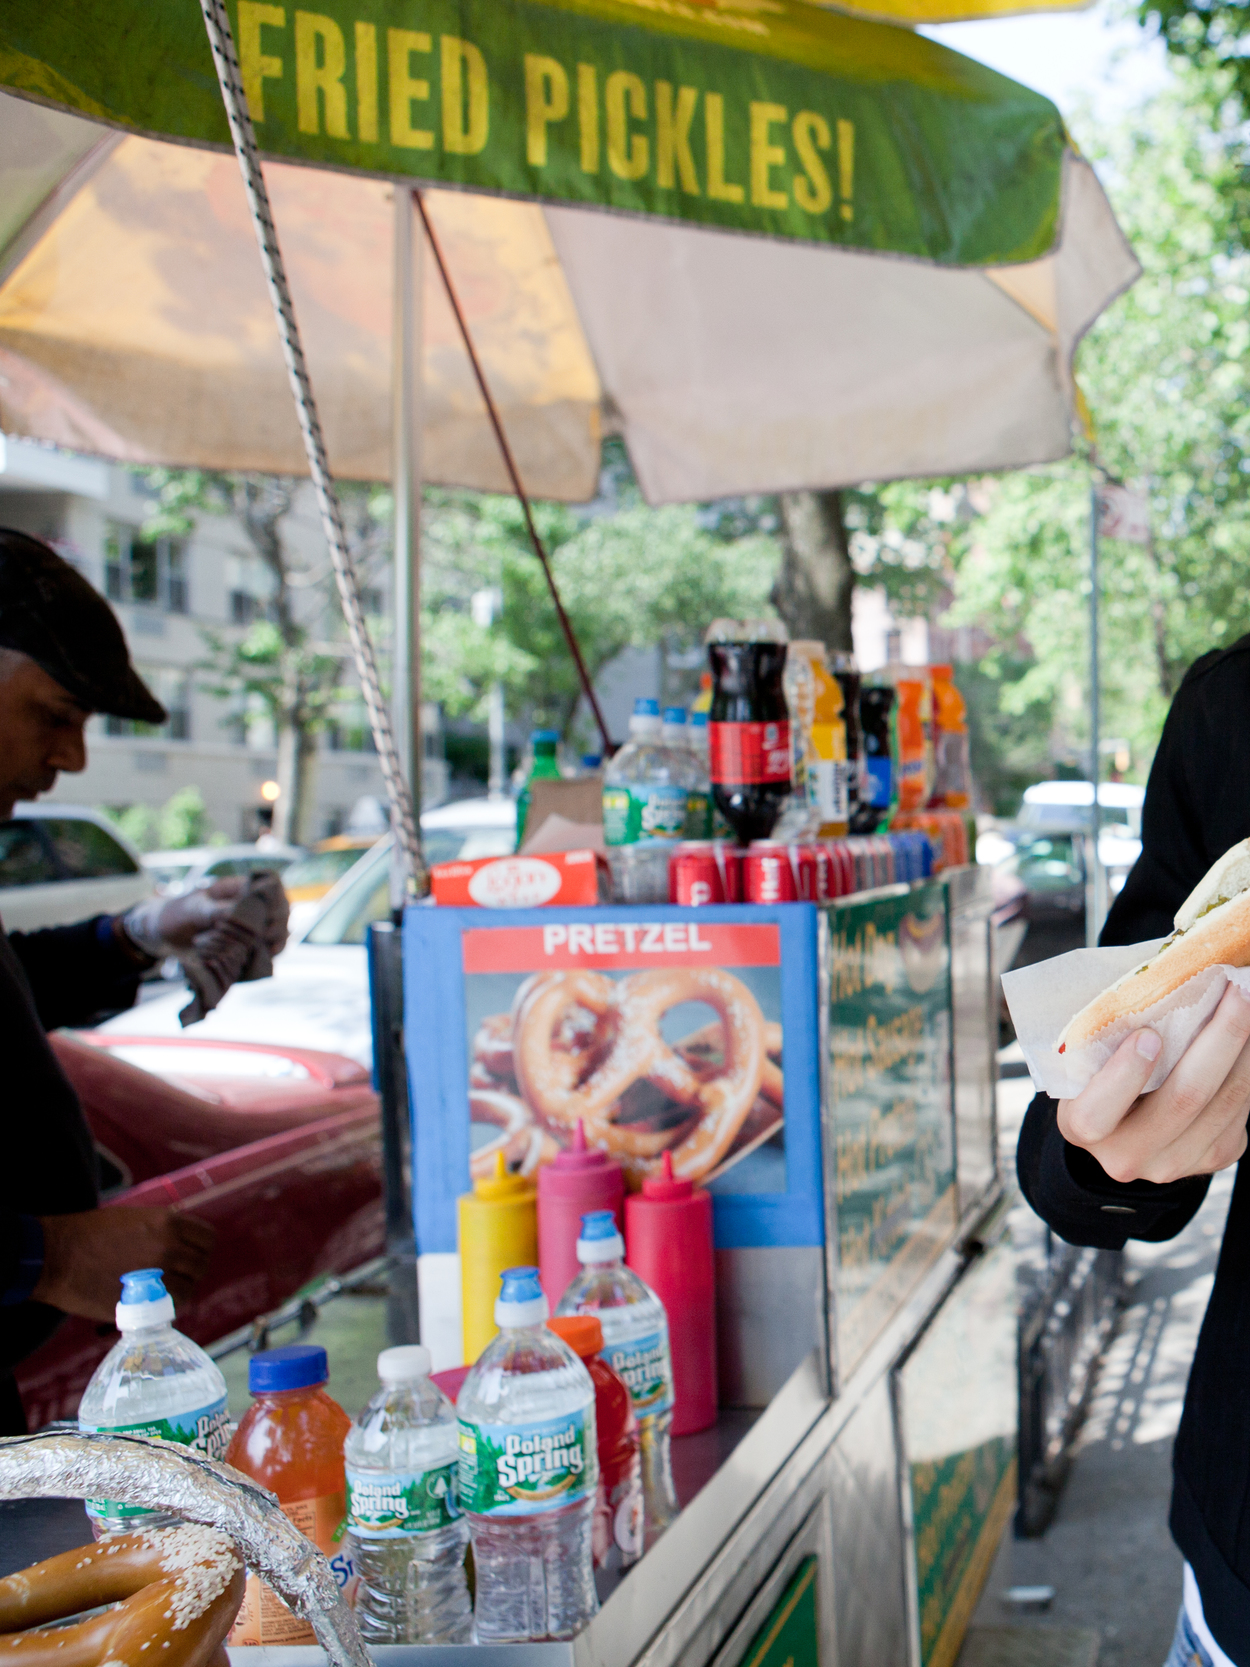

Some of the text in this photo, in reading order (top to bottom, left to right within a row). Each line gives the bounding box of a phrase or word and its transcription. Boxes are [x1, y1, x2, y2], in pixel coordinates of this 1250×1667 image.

[237, 1, 855, 221] FRIED PICKLES!
[543, 922, 713, 956] PRETZEL
[505, 1424, 575, 1457] Poland
[497, 1444, 583, 1488] Spring
[354, 1480, 401, 1497] Poland
[351, 1493, 409, 1519] Spring
